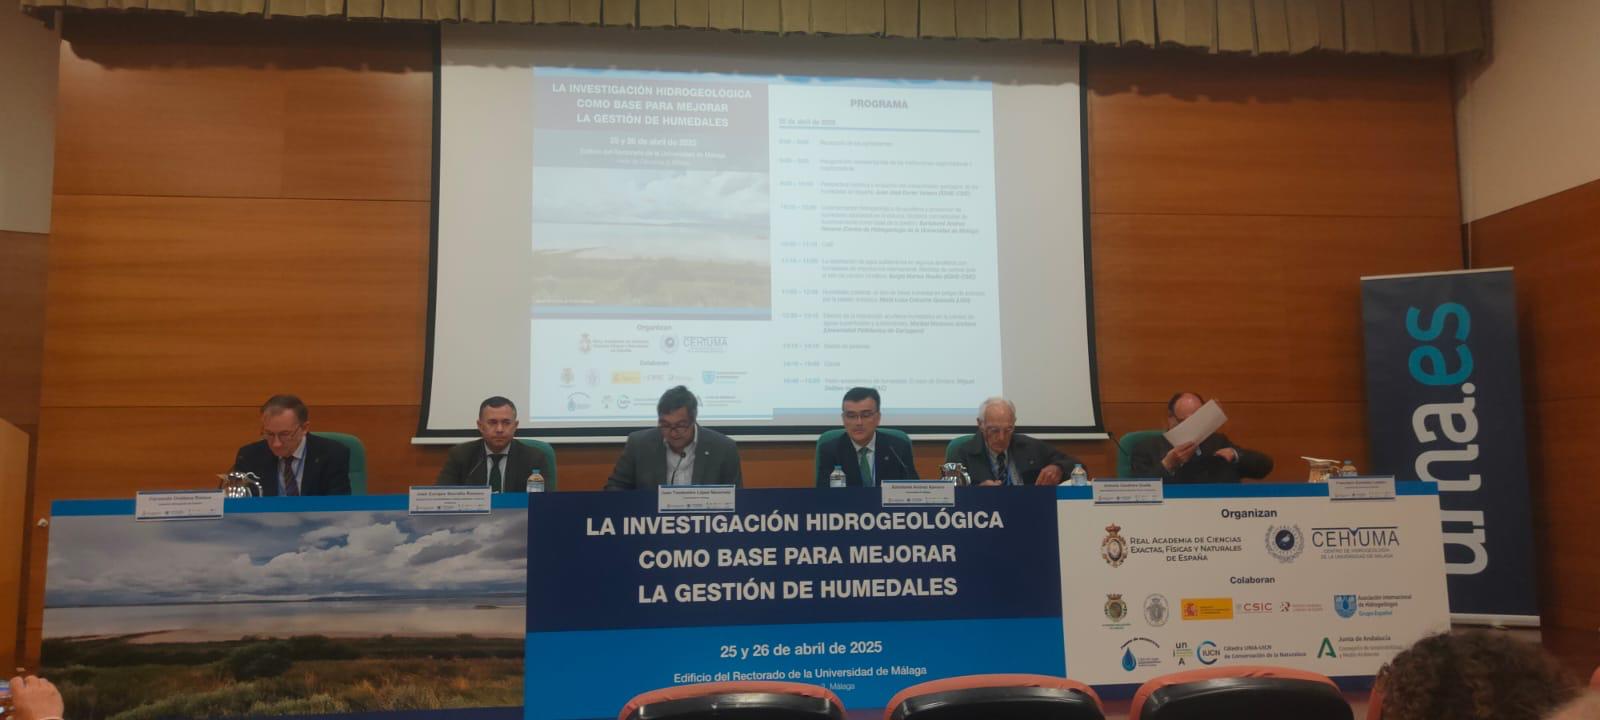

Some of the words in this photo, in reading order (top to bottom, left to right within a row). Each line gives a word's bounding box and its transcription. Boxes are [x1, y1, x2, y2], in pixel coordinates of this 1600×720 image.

[552, 84, 566, 92] LA
[570, 84, 652, 96] INVESTIGACIÓN
[656, 87, 752, 98] HIDROGEOLÓGICA
[576, 99, 610, 109] COMO
[614, 100, 642, 110] BASE
[646, 102, 674, 111] PARA
[677, 102, 729, 112] MEJORAR
[850, 98, 908, 110] PROGRAMA
[576, 114, 591, 124] LA
[594, 112, 642, 124] GESTIÓN
[645, 116, 660, 125] DE
[662, 117, 728, 127] HUMEDALES
[1221, 508, 1278, 520] Organizan
[586, 517, 616, 536] LA
[624, 510, 798, 534] INVESTIGACIÓN
[806, 508, 1004, 530] HIDROGEOLÓGICA
[639, 550, 710, 568] COMO
[717, 548, 777, 567] BASE
[784, 547, 843, 565] PARA
[850, 545, 956, 564] MEJORAR
[1178, 553, 1208, 561] ESPAÑA
[1230, 576, 1275, 584] Colaboran
[639, 585, 668, 603] LA
[675, 578, 775, 602] GESTIÓN
[783, 581, 814, 599] DE
[821, 578, 958, 598] HUMEDALES
[1244, 602, 1273, 611] CSIC
[720, 645, 737, 658] 25
[741, 647, 749, 660] y
[752, 644, 769, 657] 26
[773, 643, 790, 656] de
[795, 642, 825, 655] abril
[829, 642, 846, 654] de
[850, 641, 883, 654] 2025
[674, 673, 712, 684] Edificio
[714, 672, 730, 682] del
[732, 670, 785, 682] Rectorado
[788, 670, 800, 680] de
[803, 669, 812, 679] la
[815, 667, 874, 678] Universidad
[876, 666, 888, 676] de
[891, 665, 927, 677] Málaga
